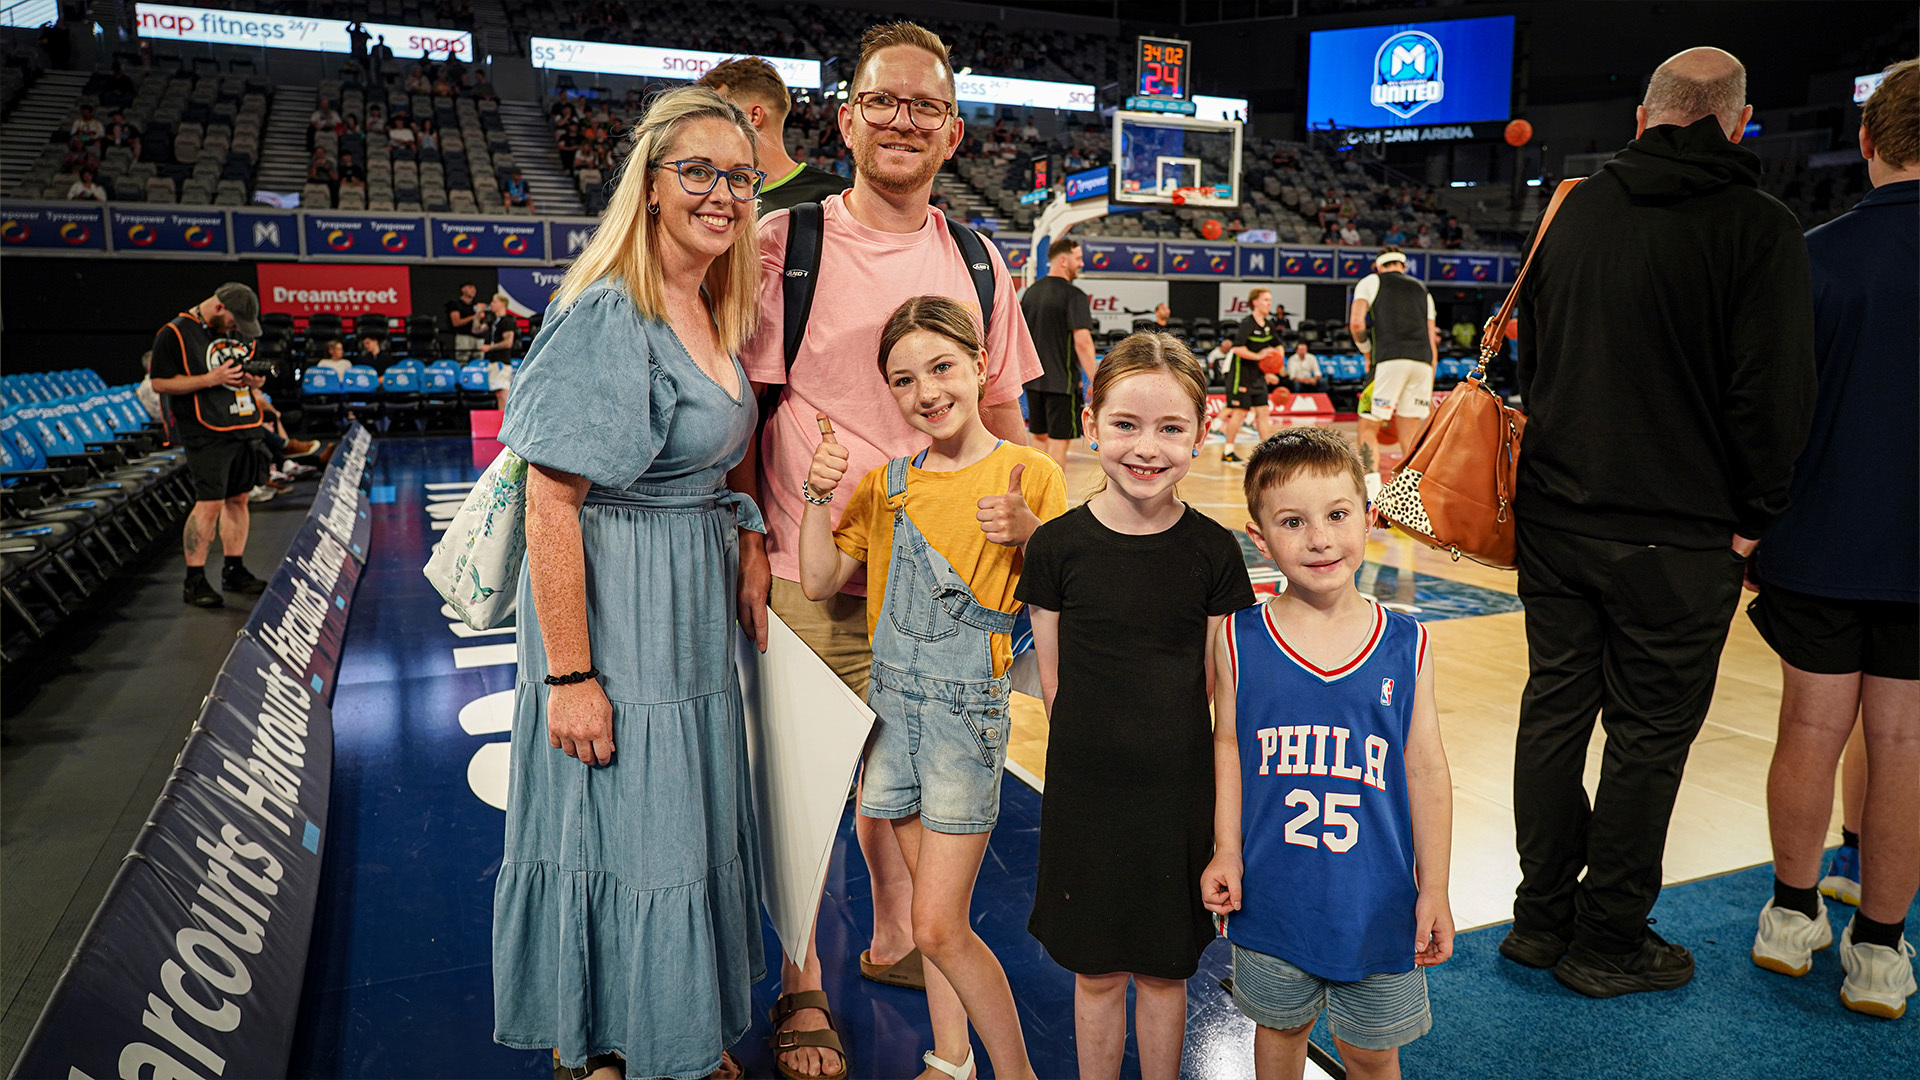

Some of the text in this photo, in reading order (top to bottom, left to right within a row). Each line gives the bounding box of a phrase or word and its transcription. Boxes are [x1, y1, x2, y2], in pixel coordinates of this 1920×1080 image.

[200, 13, 285, 39] fitness
[1145, 62, 1180, 94] 24
[1375, 80, 1440, 104] UNITED
[46, 210, 99, 222] Tyrepower
[114, 212, 223, 226] Tyrepower Tyrepower
[315, 219, 416, 231] Tyrepower Tyrepower
[273, 286, 398, 304] Dreamstreet
[1224, 297, 1251, 313] Je
[304, 304, 371, 312] LENDING
[259, 576, 329, 679] Harcourts
[216, 661, 312, 837] Harcourts
[1256, 724, 1390, 792] PHILA
[1284, 788, 1361, 853] 25
[68, 823, 284, 1080] arcourts
